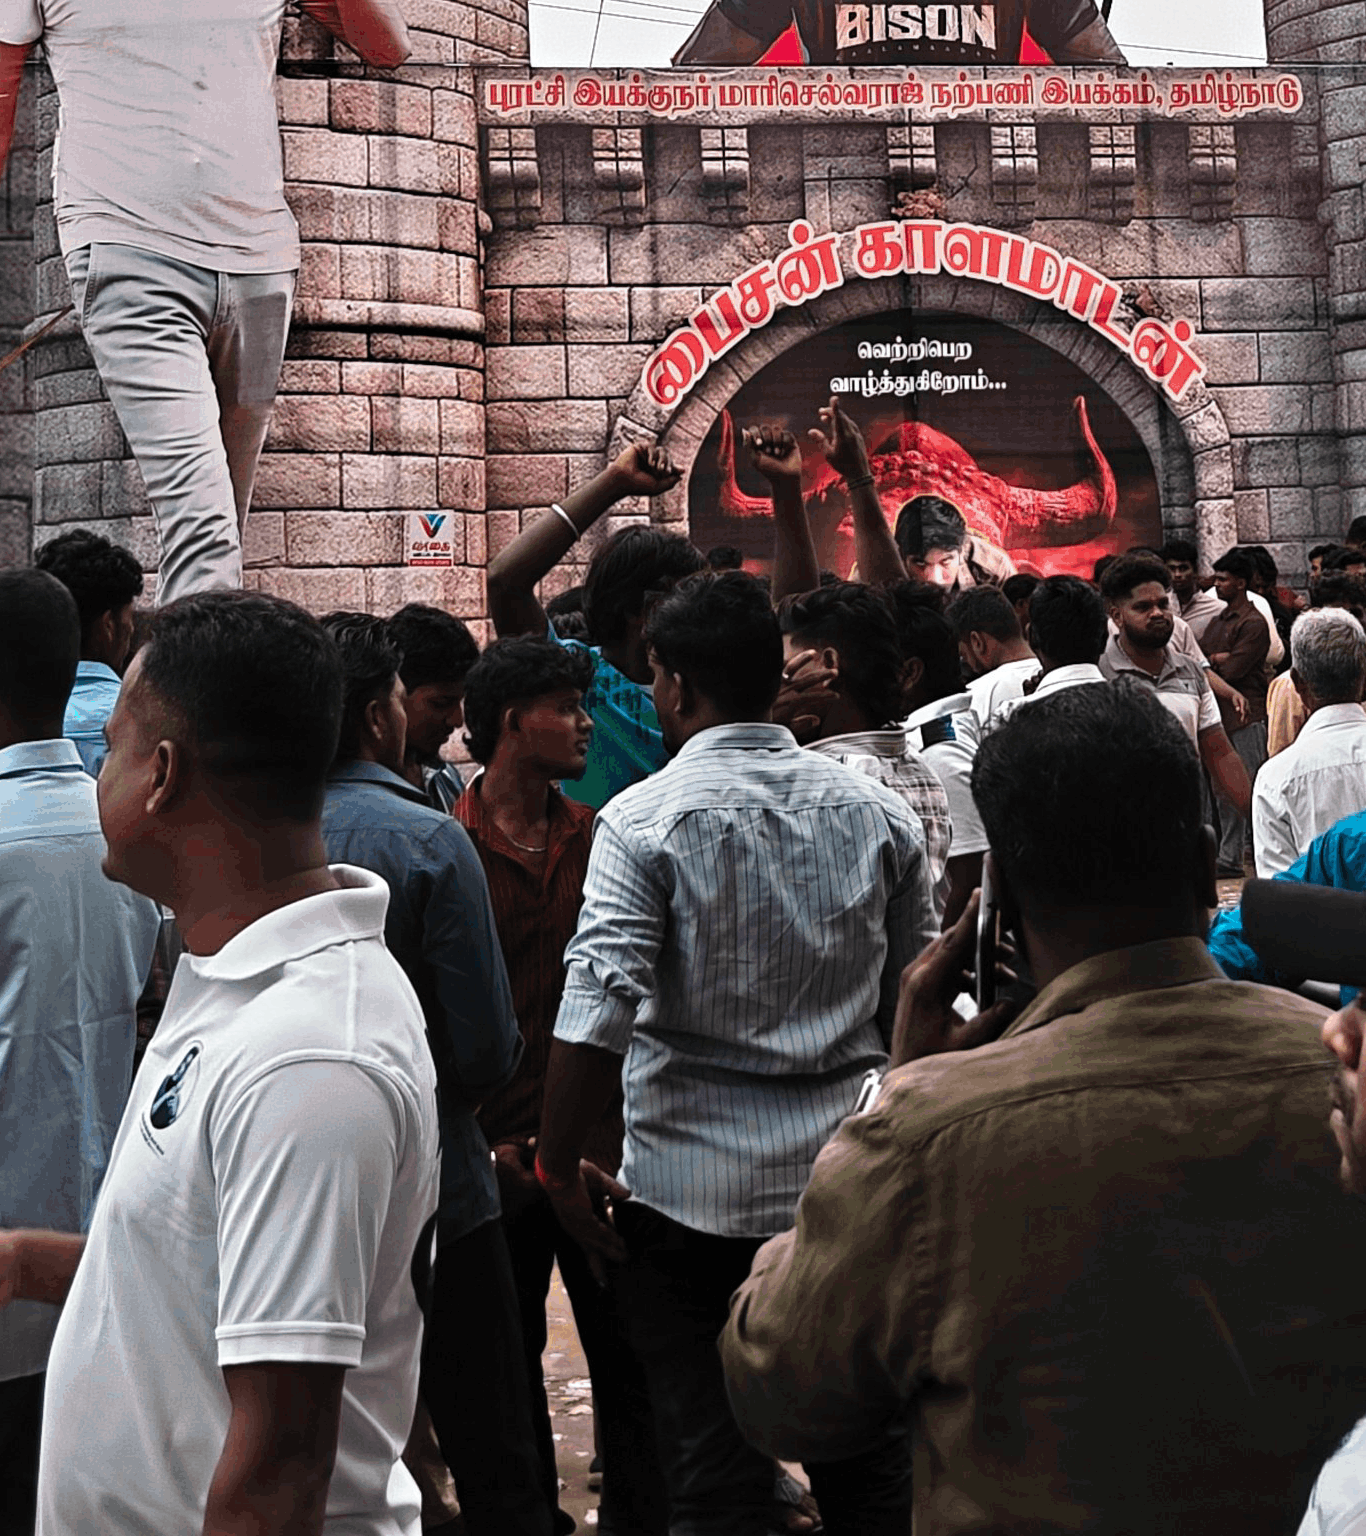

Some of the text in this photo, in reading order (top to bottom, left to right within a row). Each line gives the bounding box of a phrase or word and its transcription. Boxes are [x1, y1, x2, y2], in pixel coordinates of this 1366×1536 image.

[835, 4, 996, 50] BISON
[489, 72, 1300, 114] புரட்சி இயக்குநர் மாரிசெல்வராஜ் நற்பணி இயக்கம், தமிழ்நாடு
[645, 221, 1203, 403] பைசன் காளமாடன்
[857, 335, 973, 364] வெற்றிபெற
